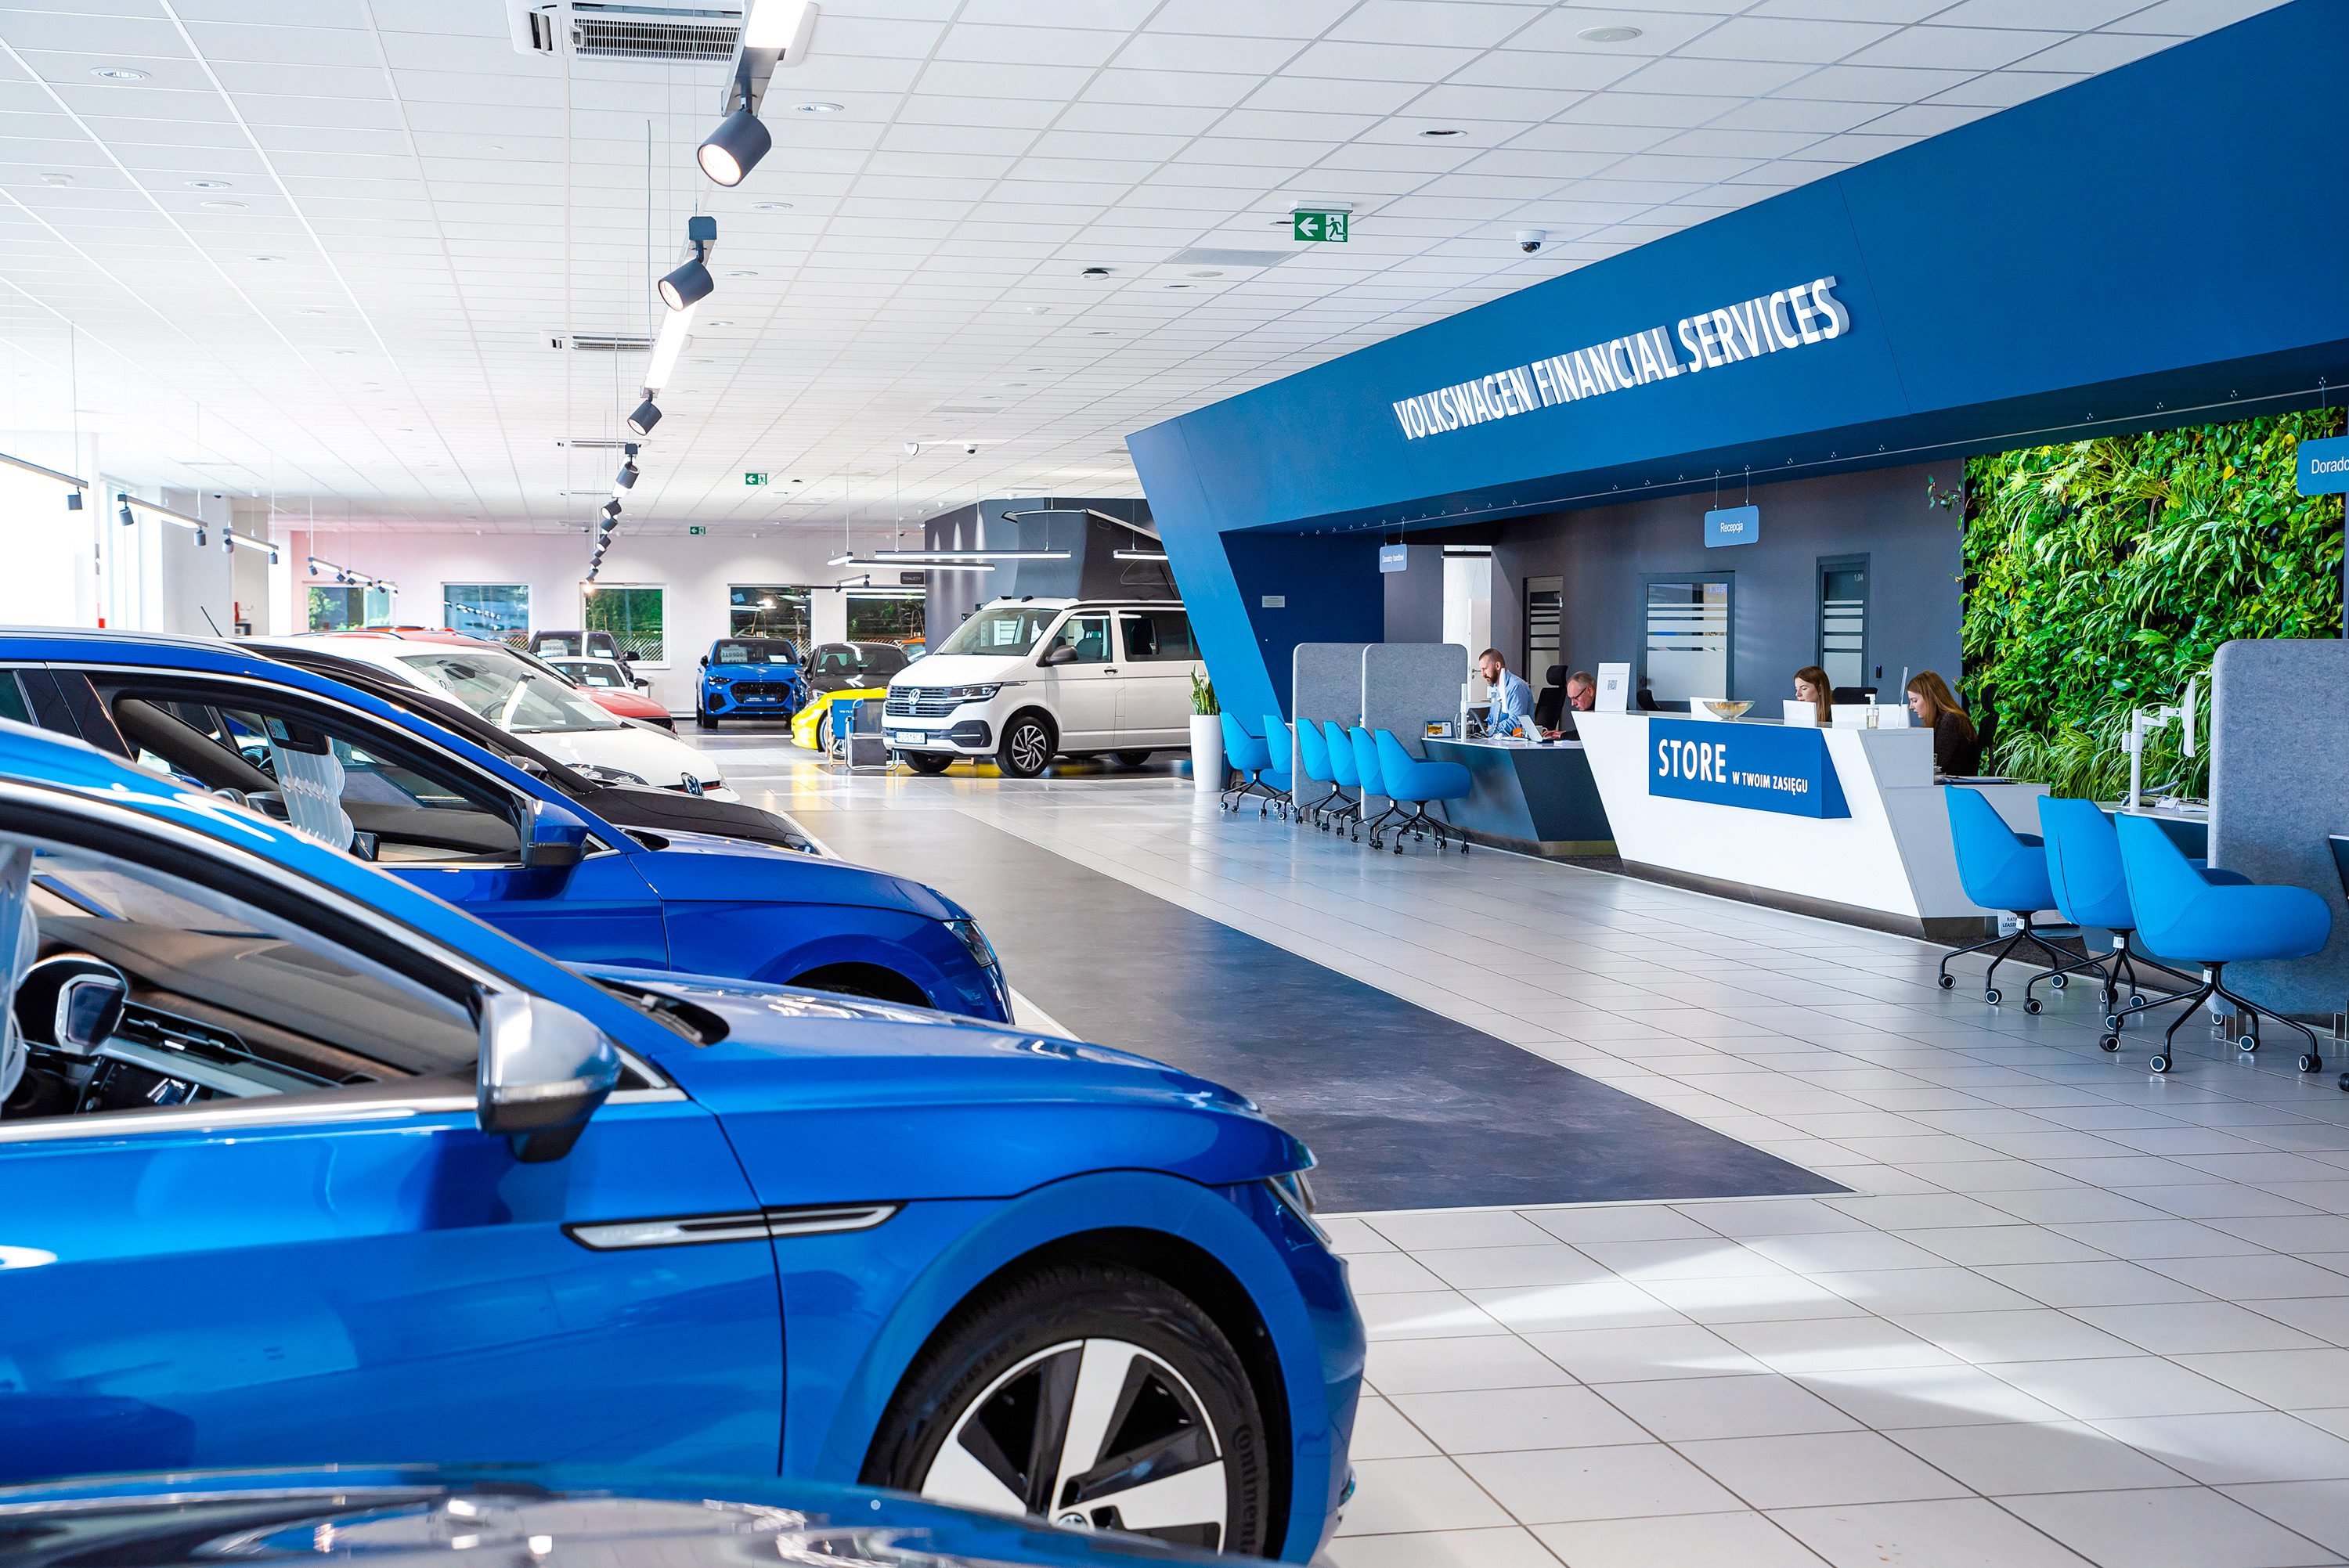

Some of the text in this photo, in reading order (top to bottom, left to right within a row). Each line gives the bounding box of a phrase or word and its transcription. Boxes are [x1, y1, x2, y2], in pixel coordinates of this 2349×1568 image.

[1392, 277, 1845, 440] VOLKSWAGEN FINANCIAL SERVICES
[1719, 521, 1744, 534] Recepcja
[1658, 739, 1808, 796] STORE W TWOIM ZASIĘGU
